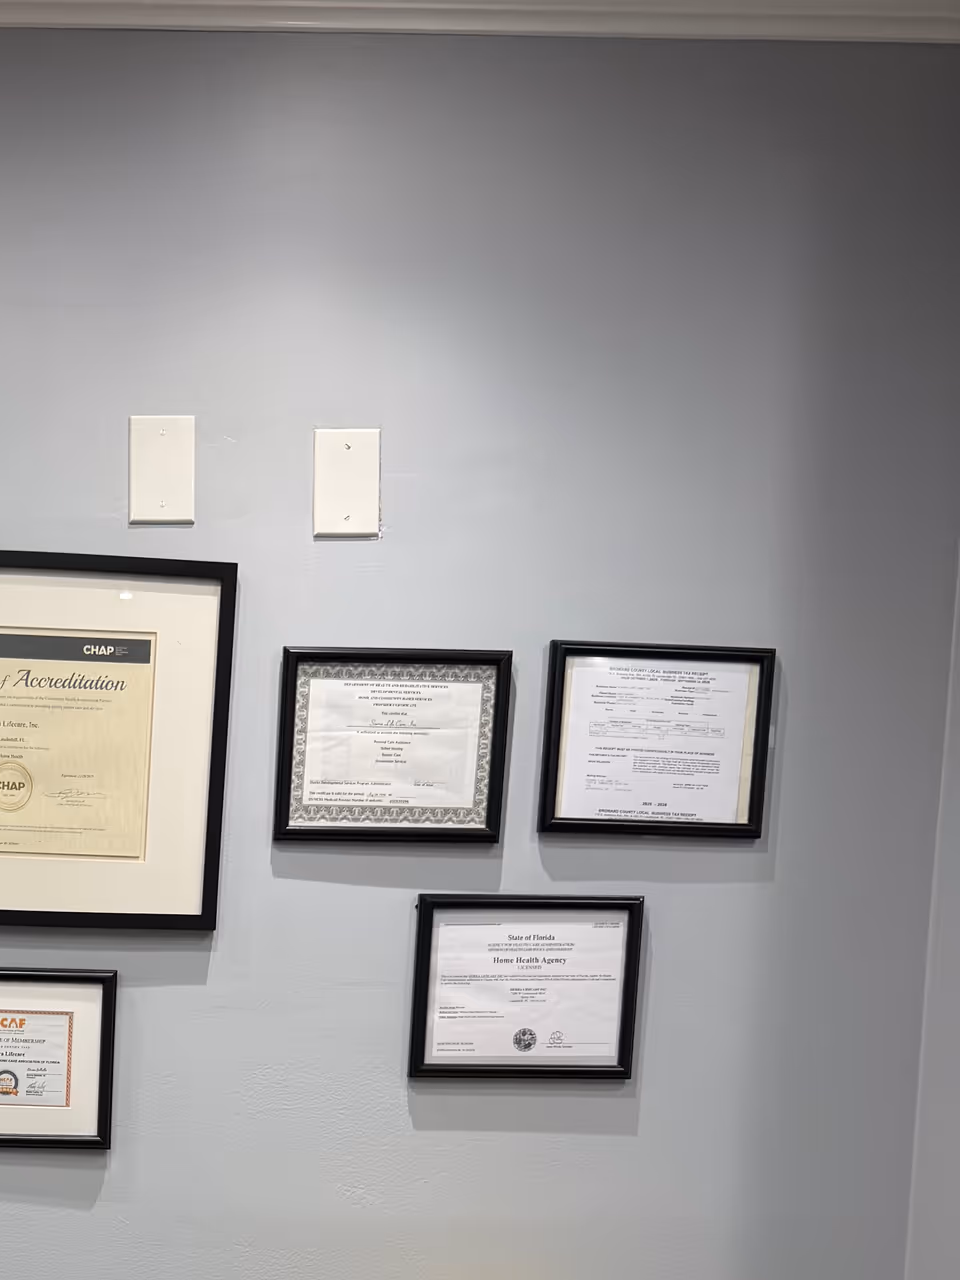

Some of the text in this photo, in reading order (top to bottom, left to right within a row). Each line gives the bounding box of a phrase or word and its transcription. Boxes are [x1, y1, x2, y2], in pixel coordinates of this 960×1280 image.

[83, 645, 114, 655] CHAP
[13, 670, 127, 691] Accreditation
[541, 958, 566, 966] Agency
